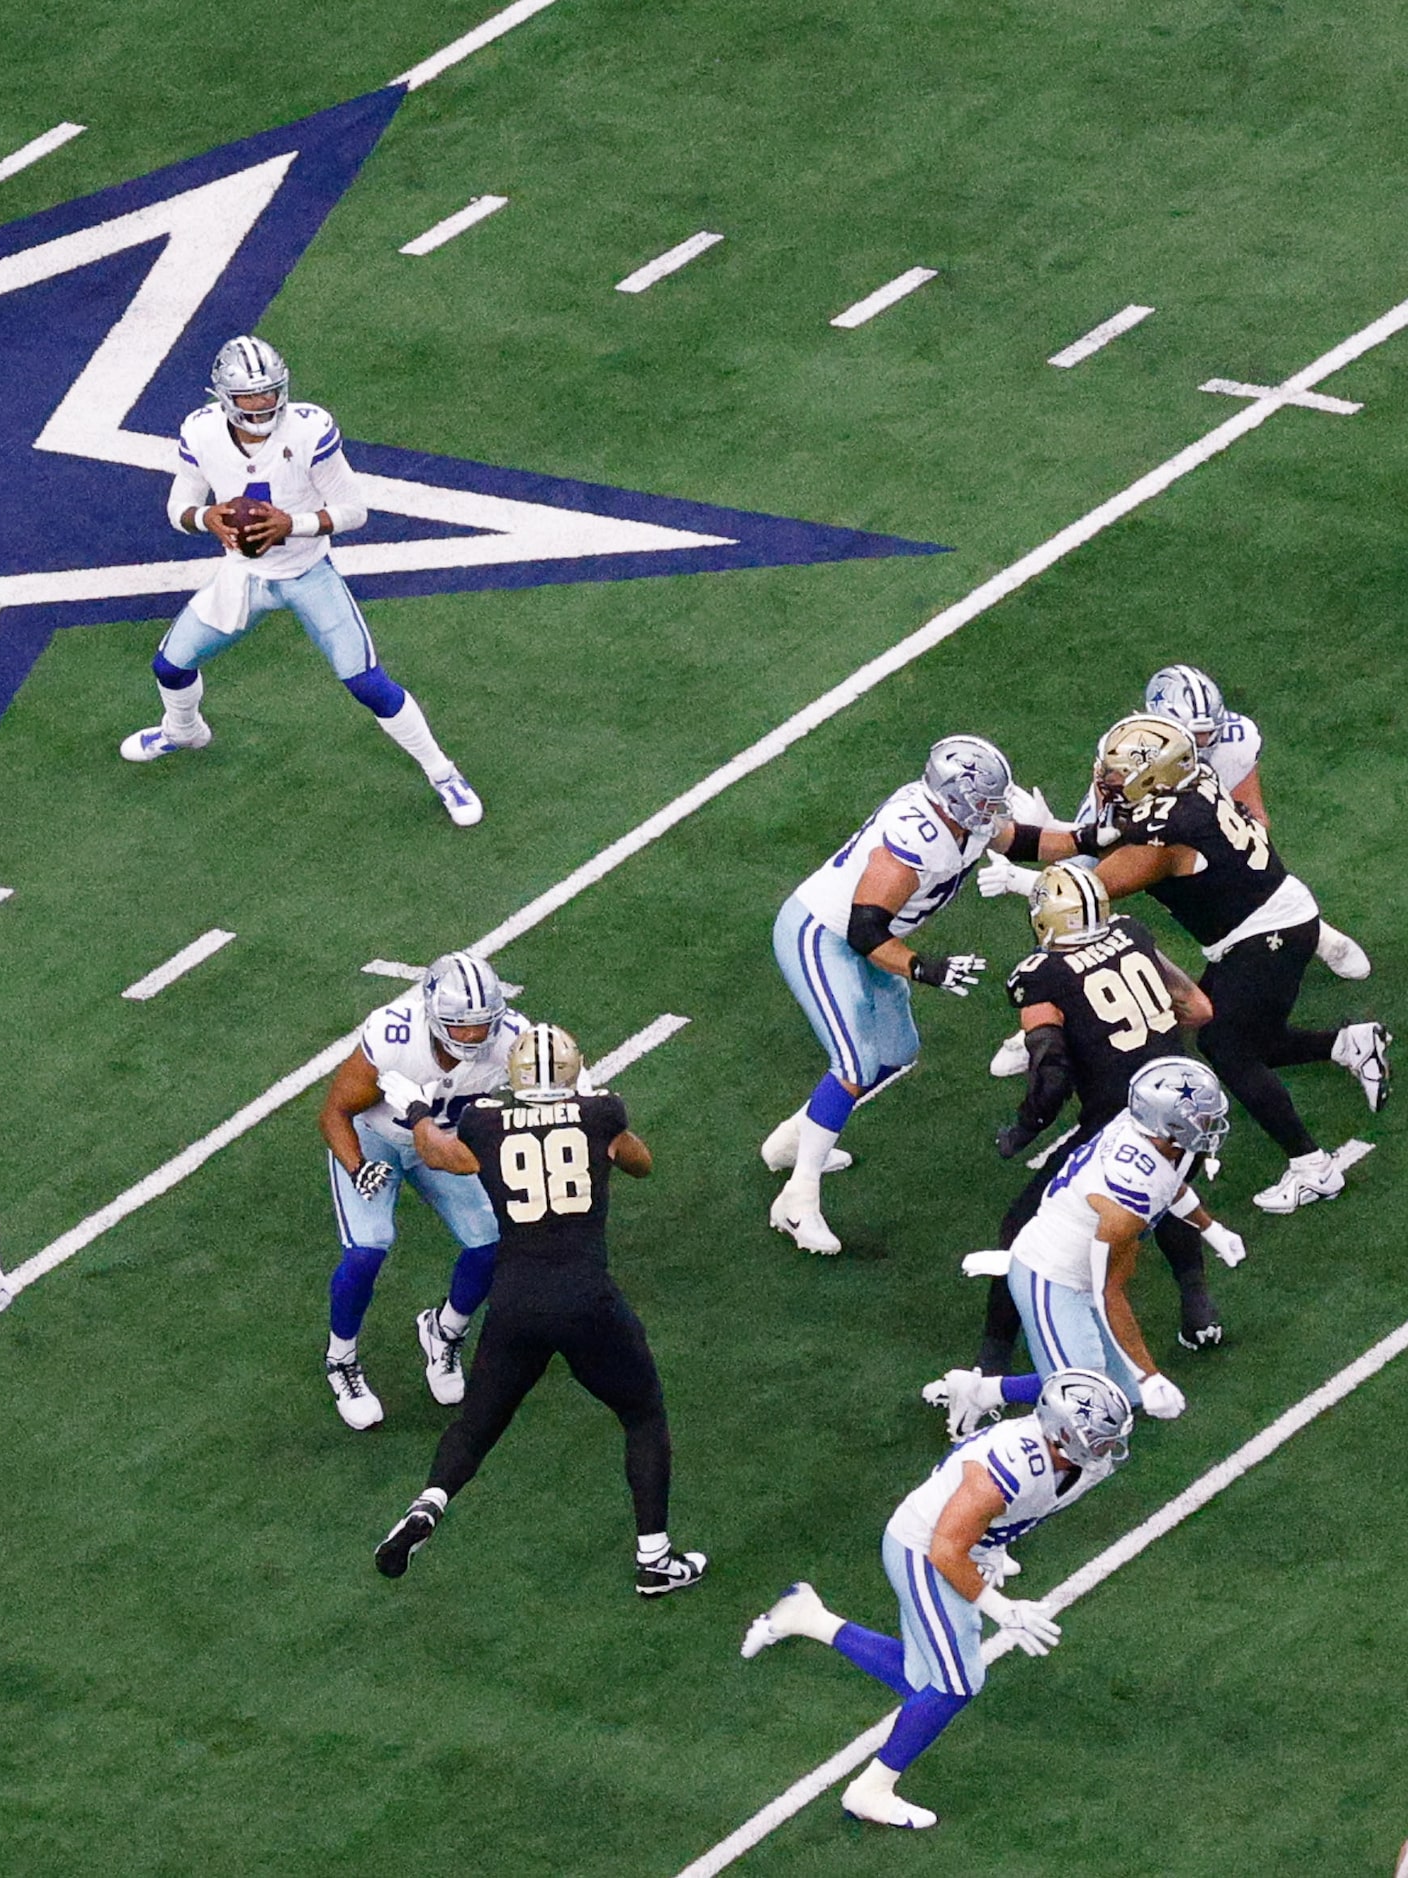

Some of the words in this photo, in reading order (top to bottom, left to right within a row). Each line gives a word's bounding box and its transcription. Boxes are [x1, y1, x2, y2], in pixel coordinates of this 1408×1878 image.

[899, 806, 939, 843] 70
[1083, 951, 1178, 1052] 90
[384, 1007, 412, 1045] 78
[500, 1101, 582, 1131] TURNER
[499, 1127, 593, 1224] 98
[1114, 1143, 1157, 1176] 89
[1020, 1435, 1046, 1477] 40
